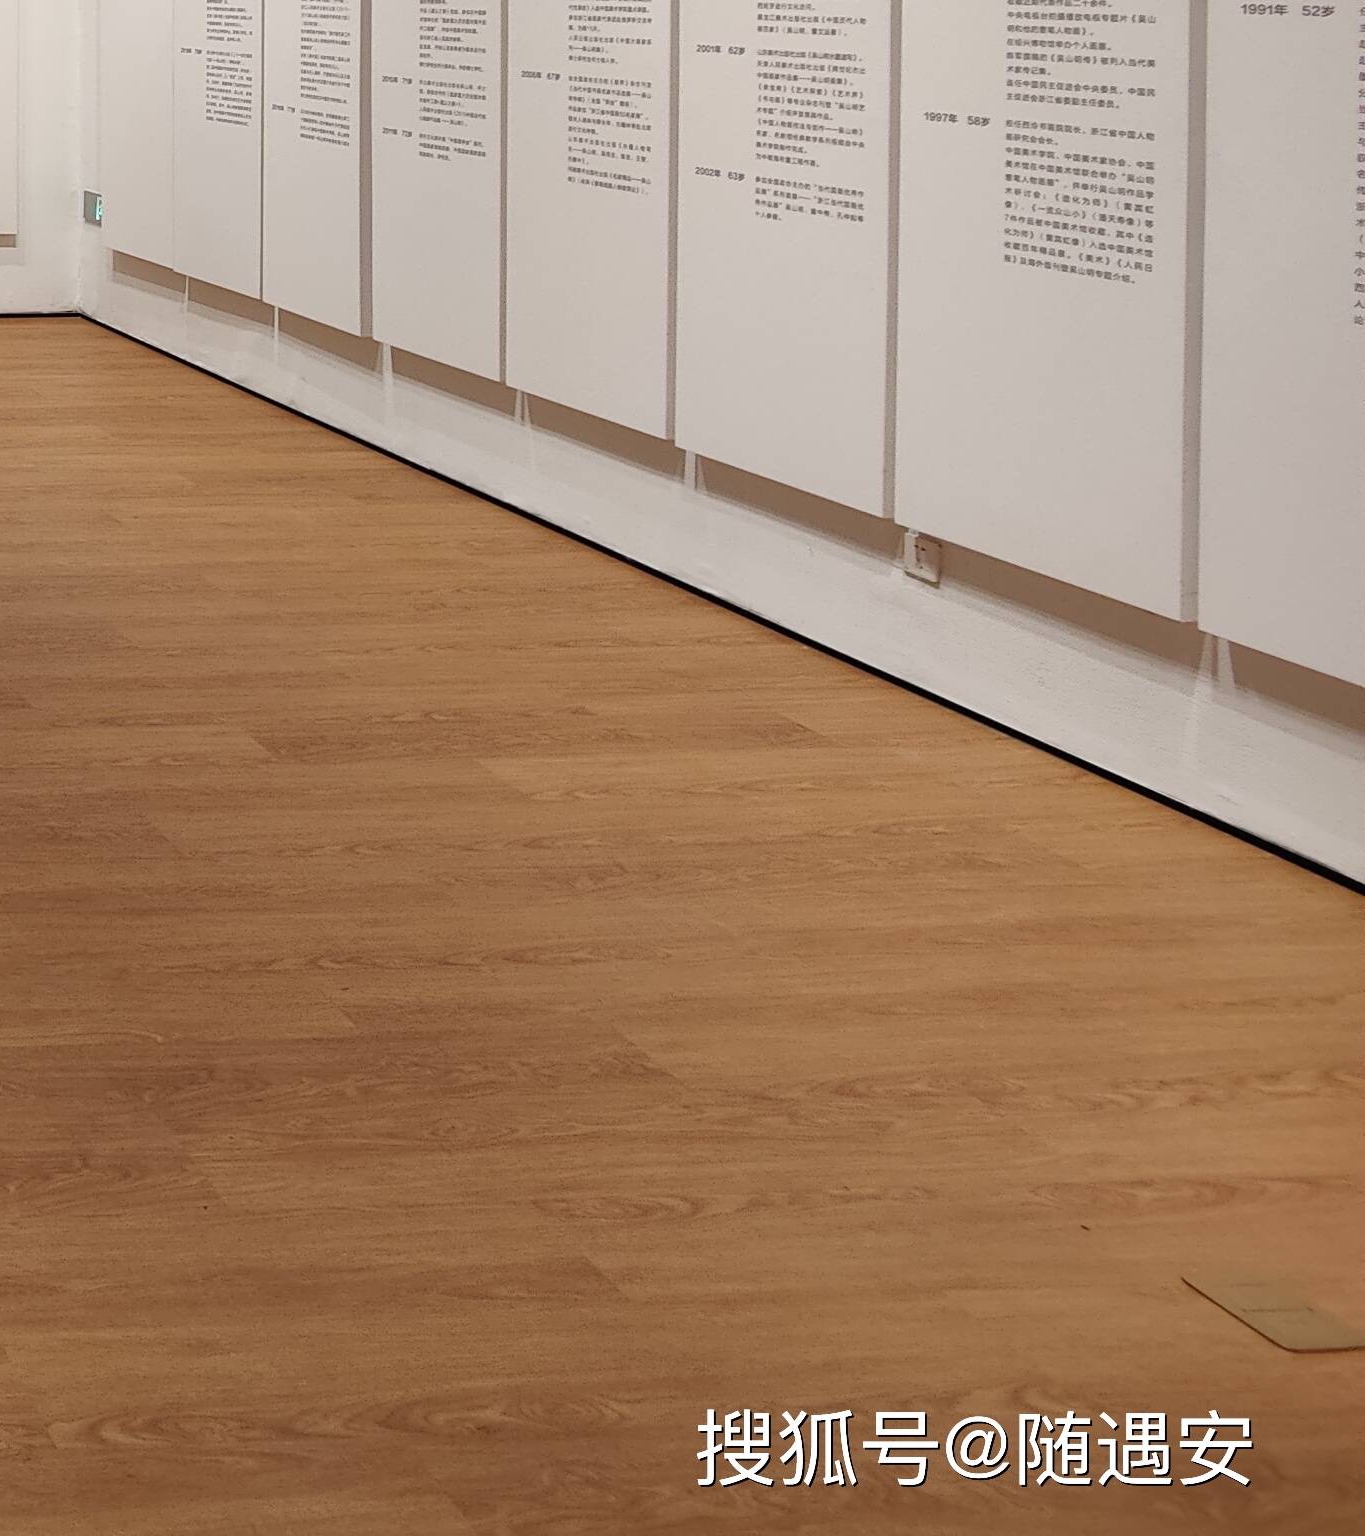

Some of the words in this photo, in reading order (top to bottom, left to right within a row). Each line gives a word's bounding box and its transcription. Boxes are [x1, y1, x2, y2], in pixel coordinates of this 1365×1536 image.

[1241, 4, 1288, 15] 1991年
[1302, 5, 1335, 17] 52岁
[924, 112, 958, 123] 1997年
[967, 116, 990, 126] 58岁
